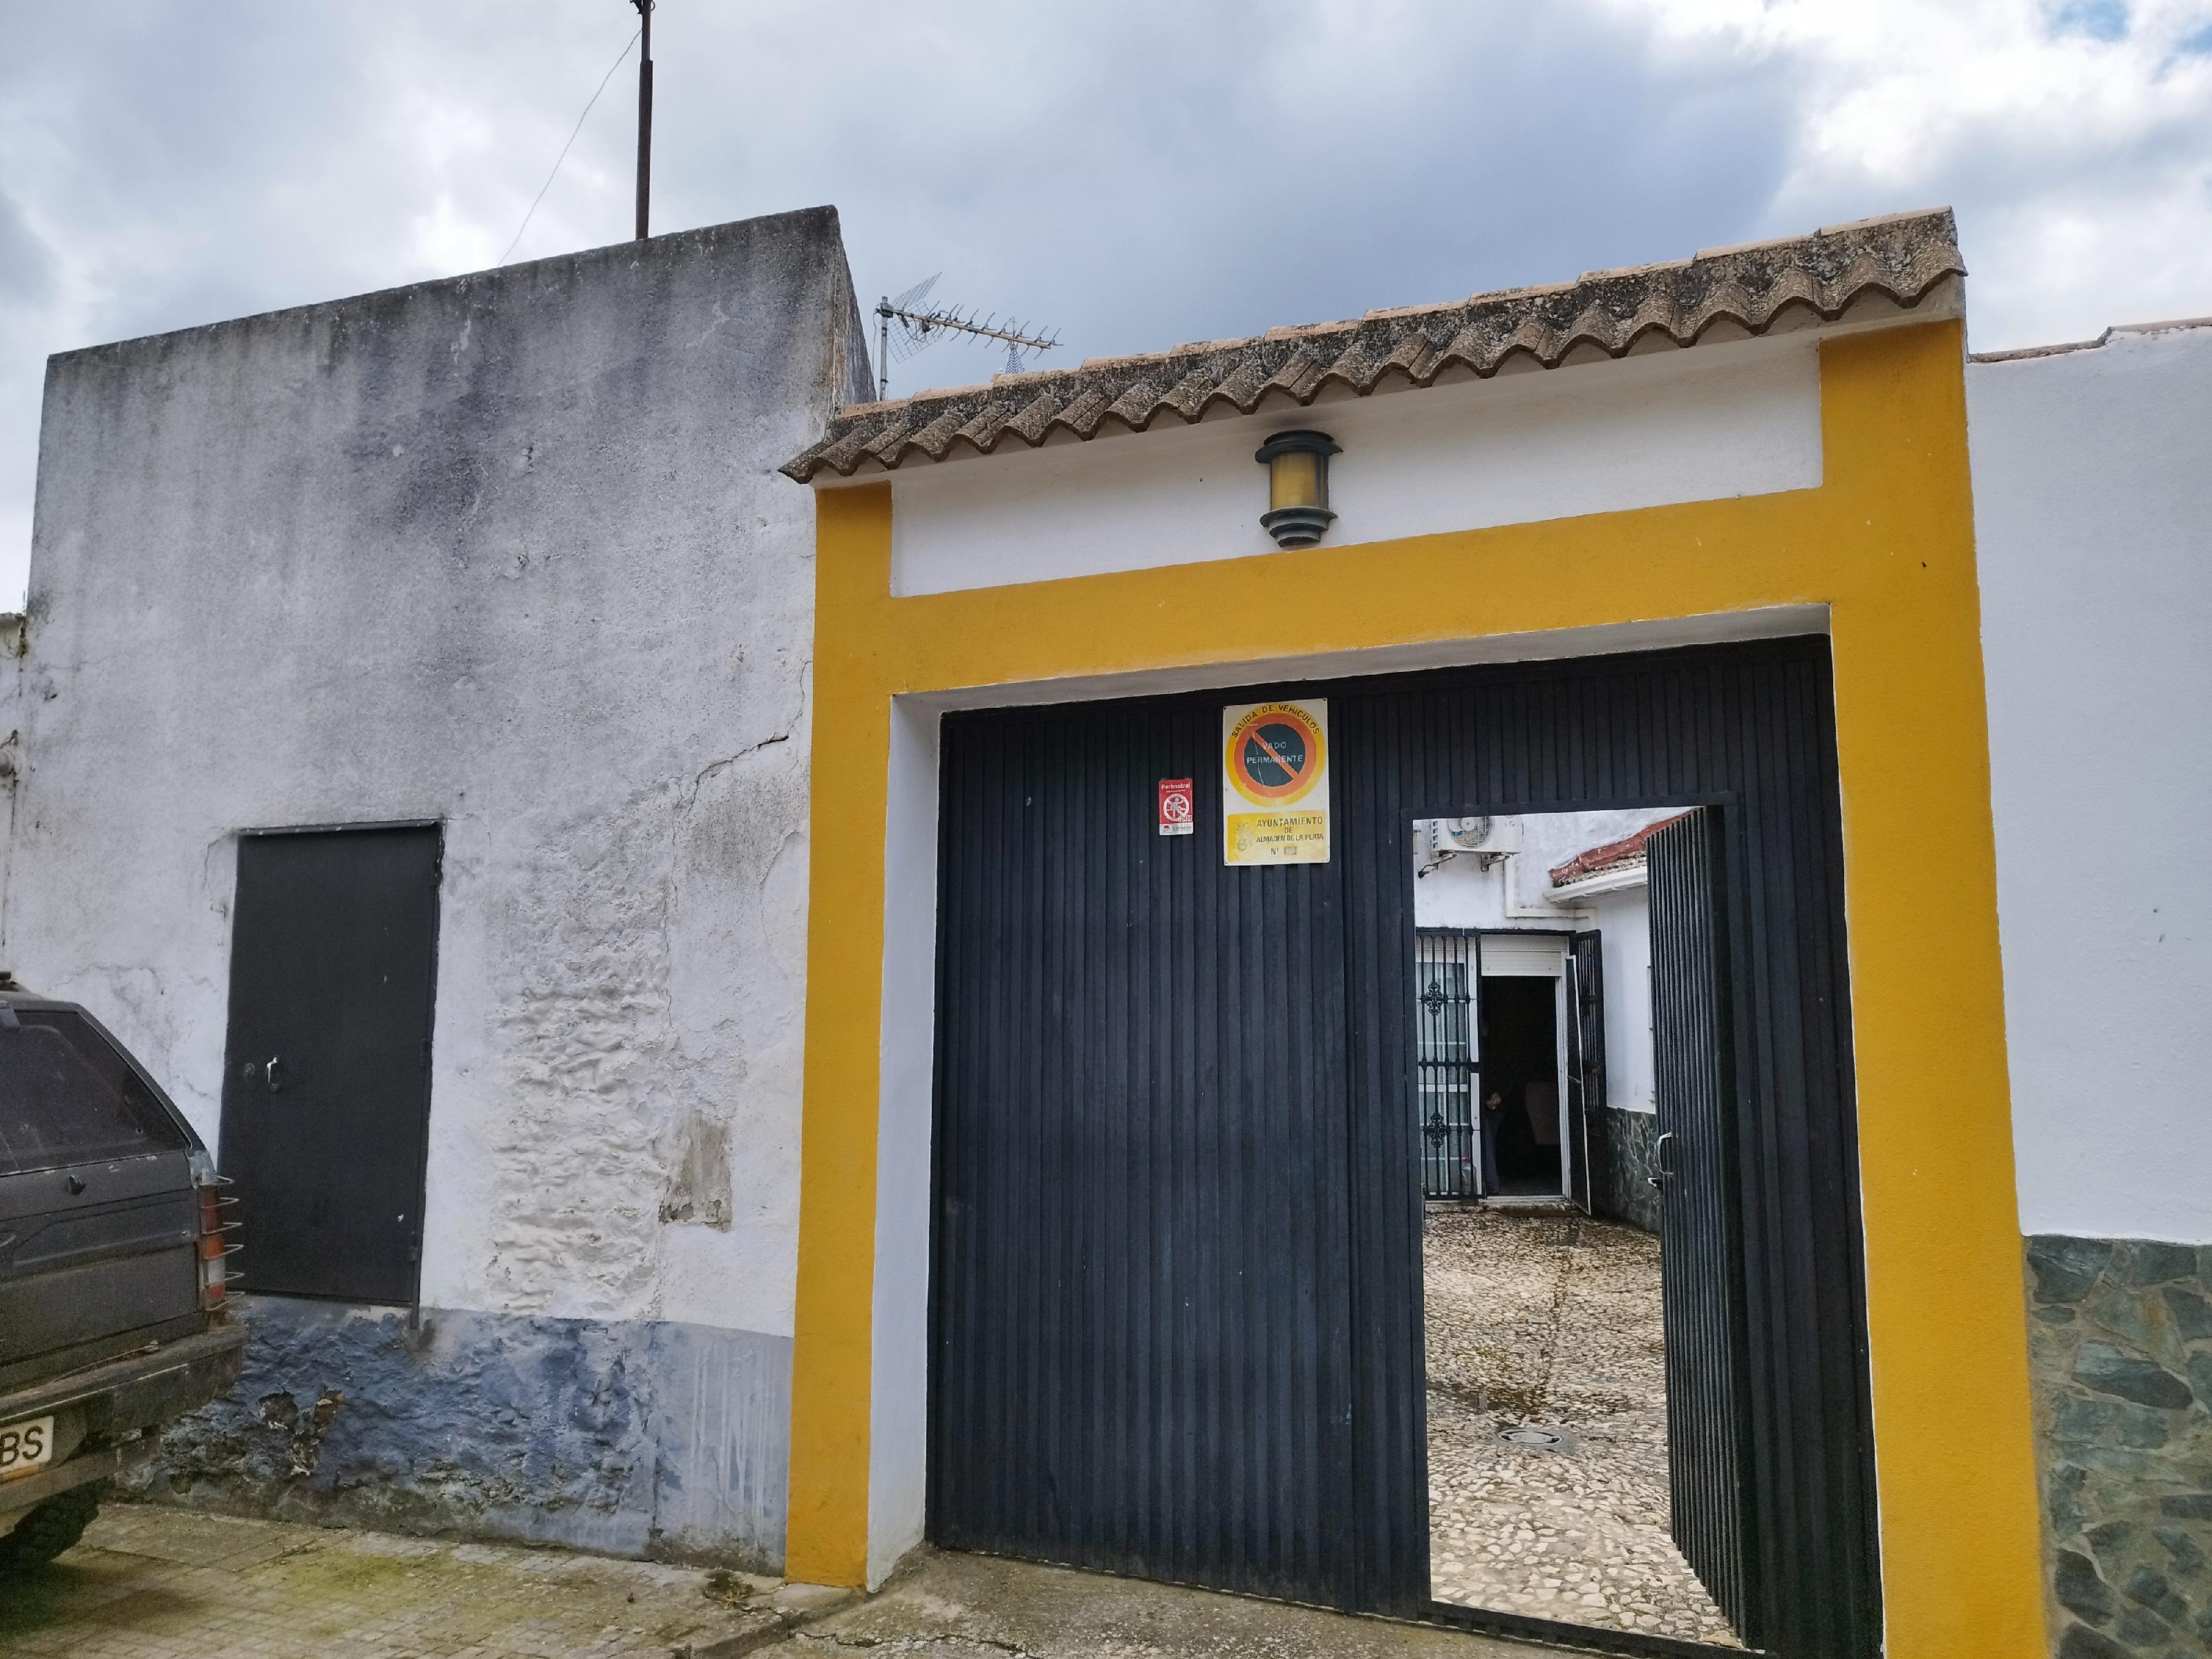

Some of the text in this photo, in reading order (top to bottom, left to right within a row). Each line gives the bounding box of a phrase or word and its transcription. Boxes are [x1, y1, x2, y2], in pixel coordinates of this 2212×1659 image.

[1232, 704, 1320, 738] SALIDA DE VEHICULOS
[1246, 754, 1303, 764] PERMANENTE
[1257, 816, 1322, 827] AYUNTAMIENTO
